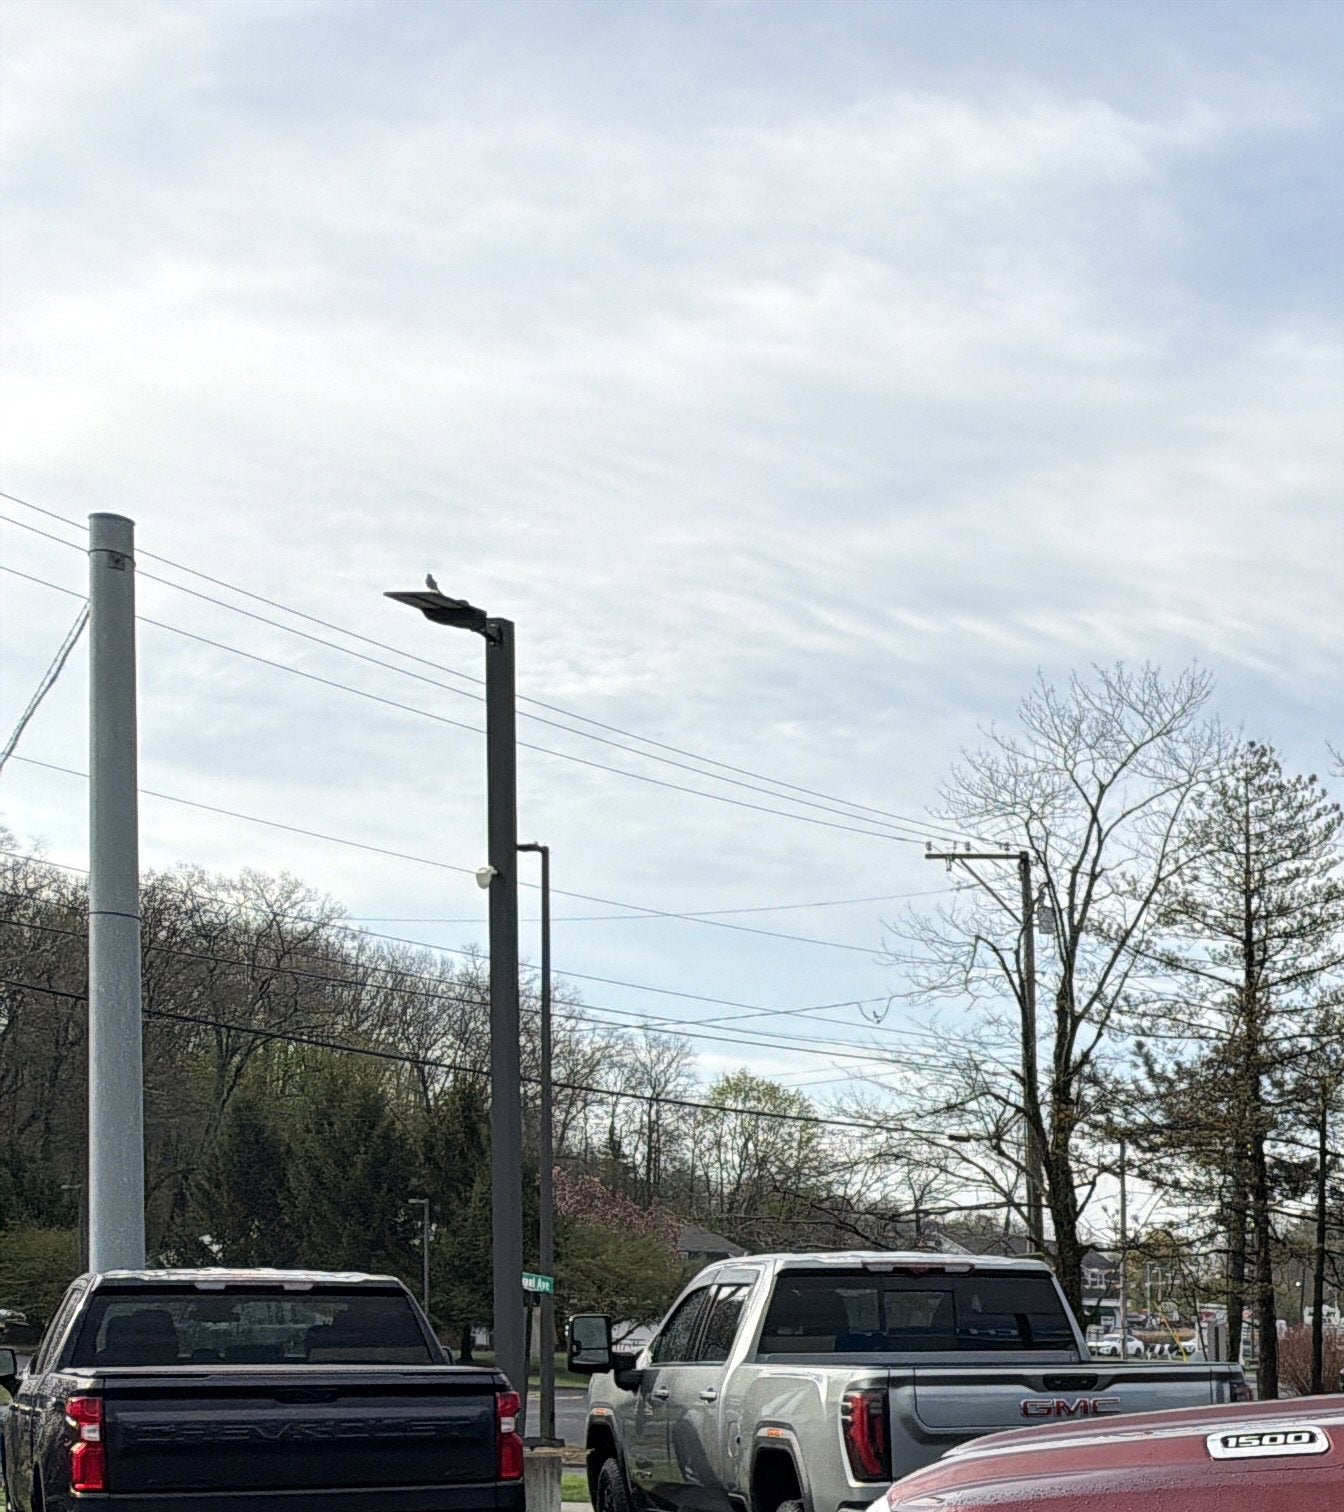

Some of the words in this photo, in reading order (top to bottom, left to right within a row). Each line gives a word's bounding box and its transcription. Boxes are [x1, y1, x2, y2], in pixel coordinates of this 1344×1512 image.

[536, 1277, 550, 1292] Ave
[1020, 1397, 1121, 1417] GMC
[1226, 1432, 1310, 1448] 1500
